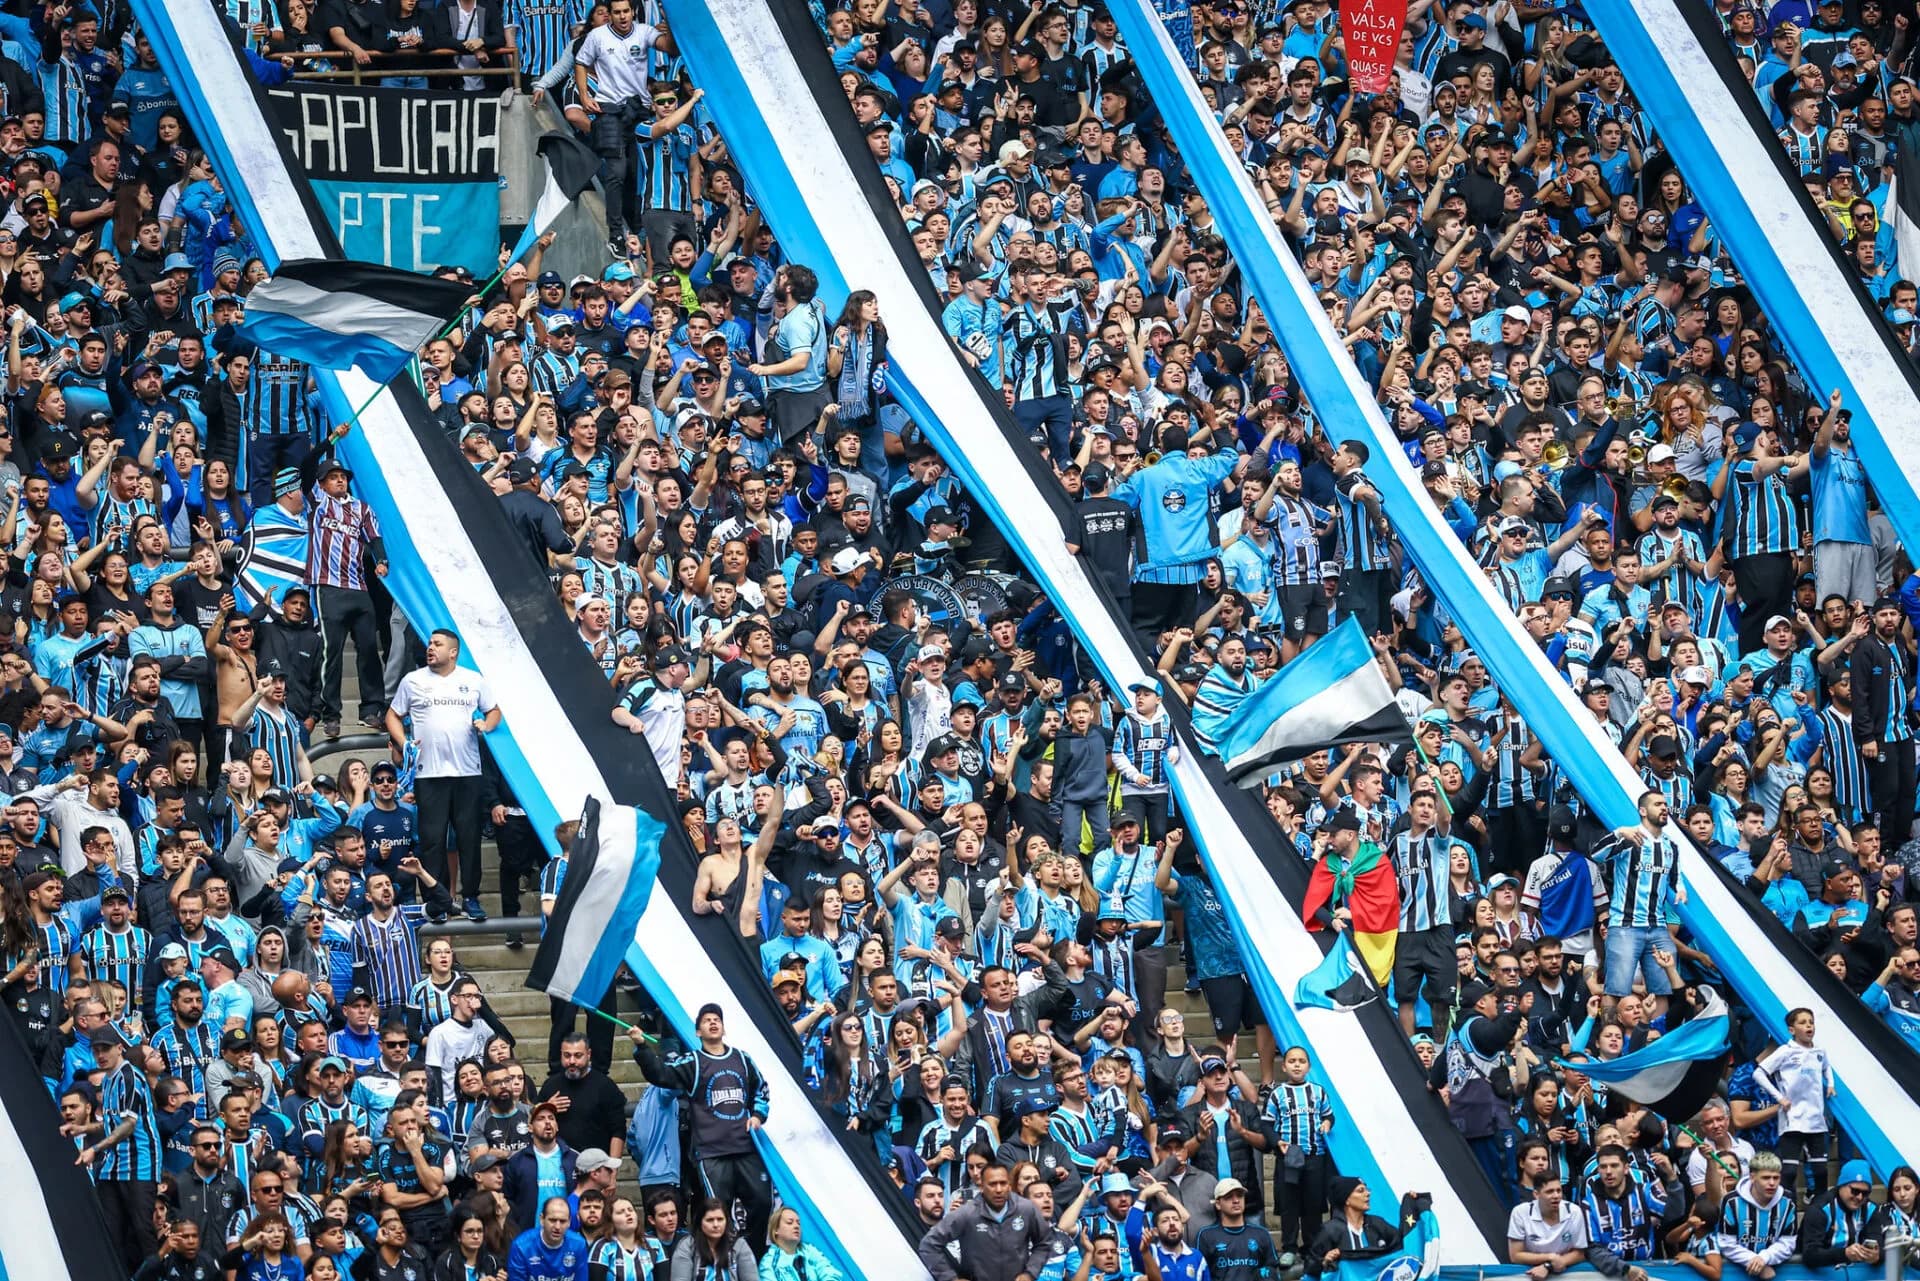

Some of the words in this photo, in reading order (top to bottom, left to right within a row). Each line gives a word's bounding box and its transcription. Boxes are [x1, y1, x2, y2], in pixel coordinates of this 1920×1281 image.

[524, 5, 564, 17] Banrisul
[1350, 12, 1395, 31] VALSA
[1353, 30, 1367, 41] DE
[1371, 32, 1392, 46] VCS
[1360, 45, 1377, 57] TA
[1351, 59, 1386, 76] QUASE
[339, 192, 441, 271] PTE
[912, 578, 960, 619] TRICOLOR
[433, 697, 473, 706] banrisu
